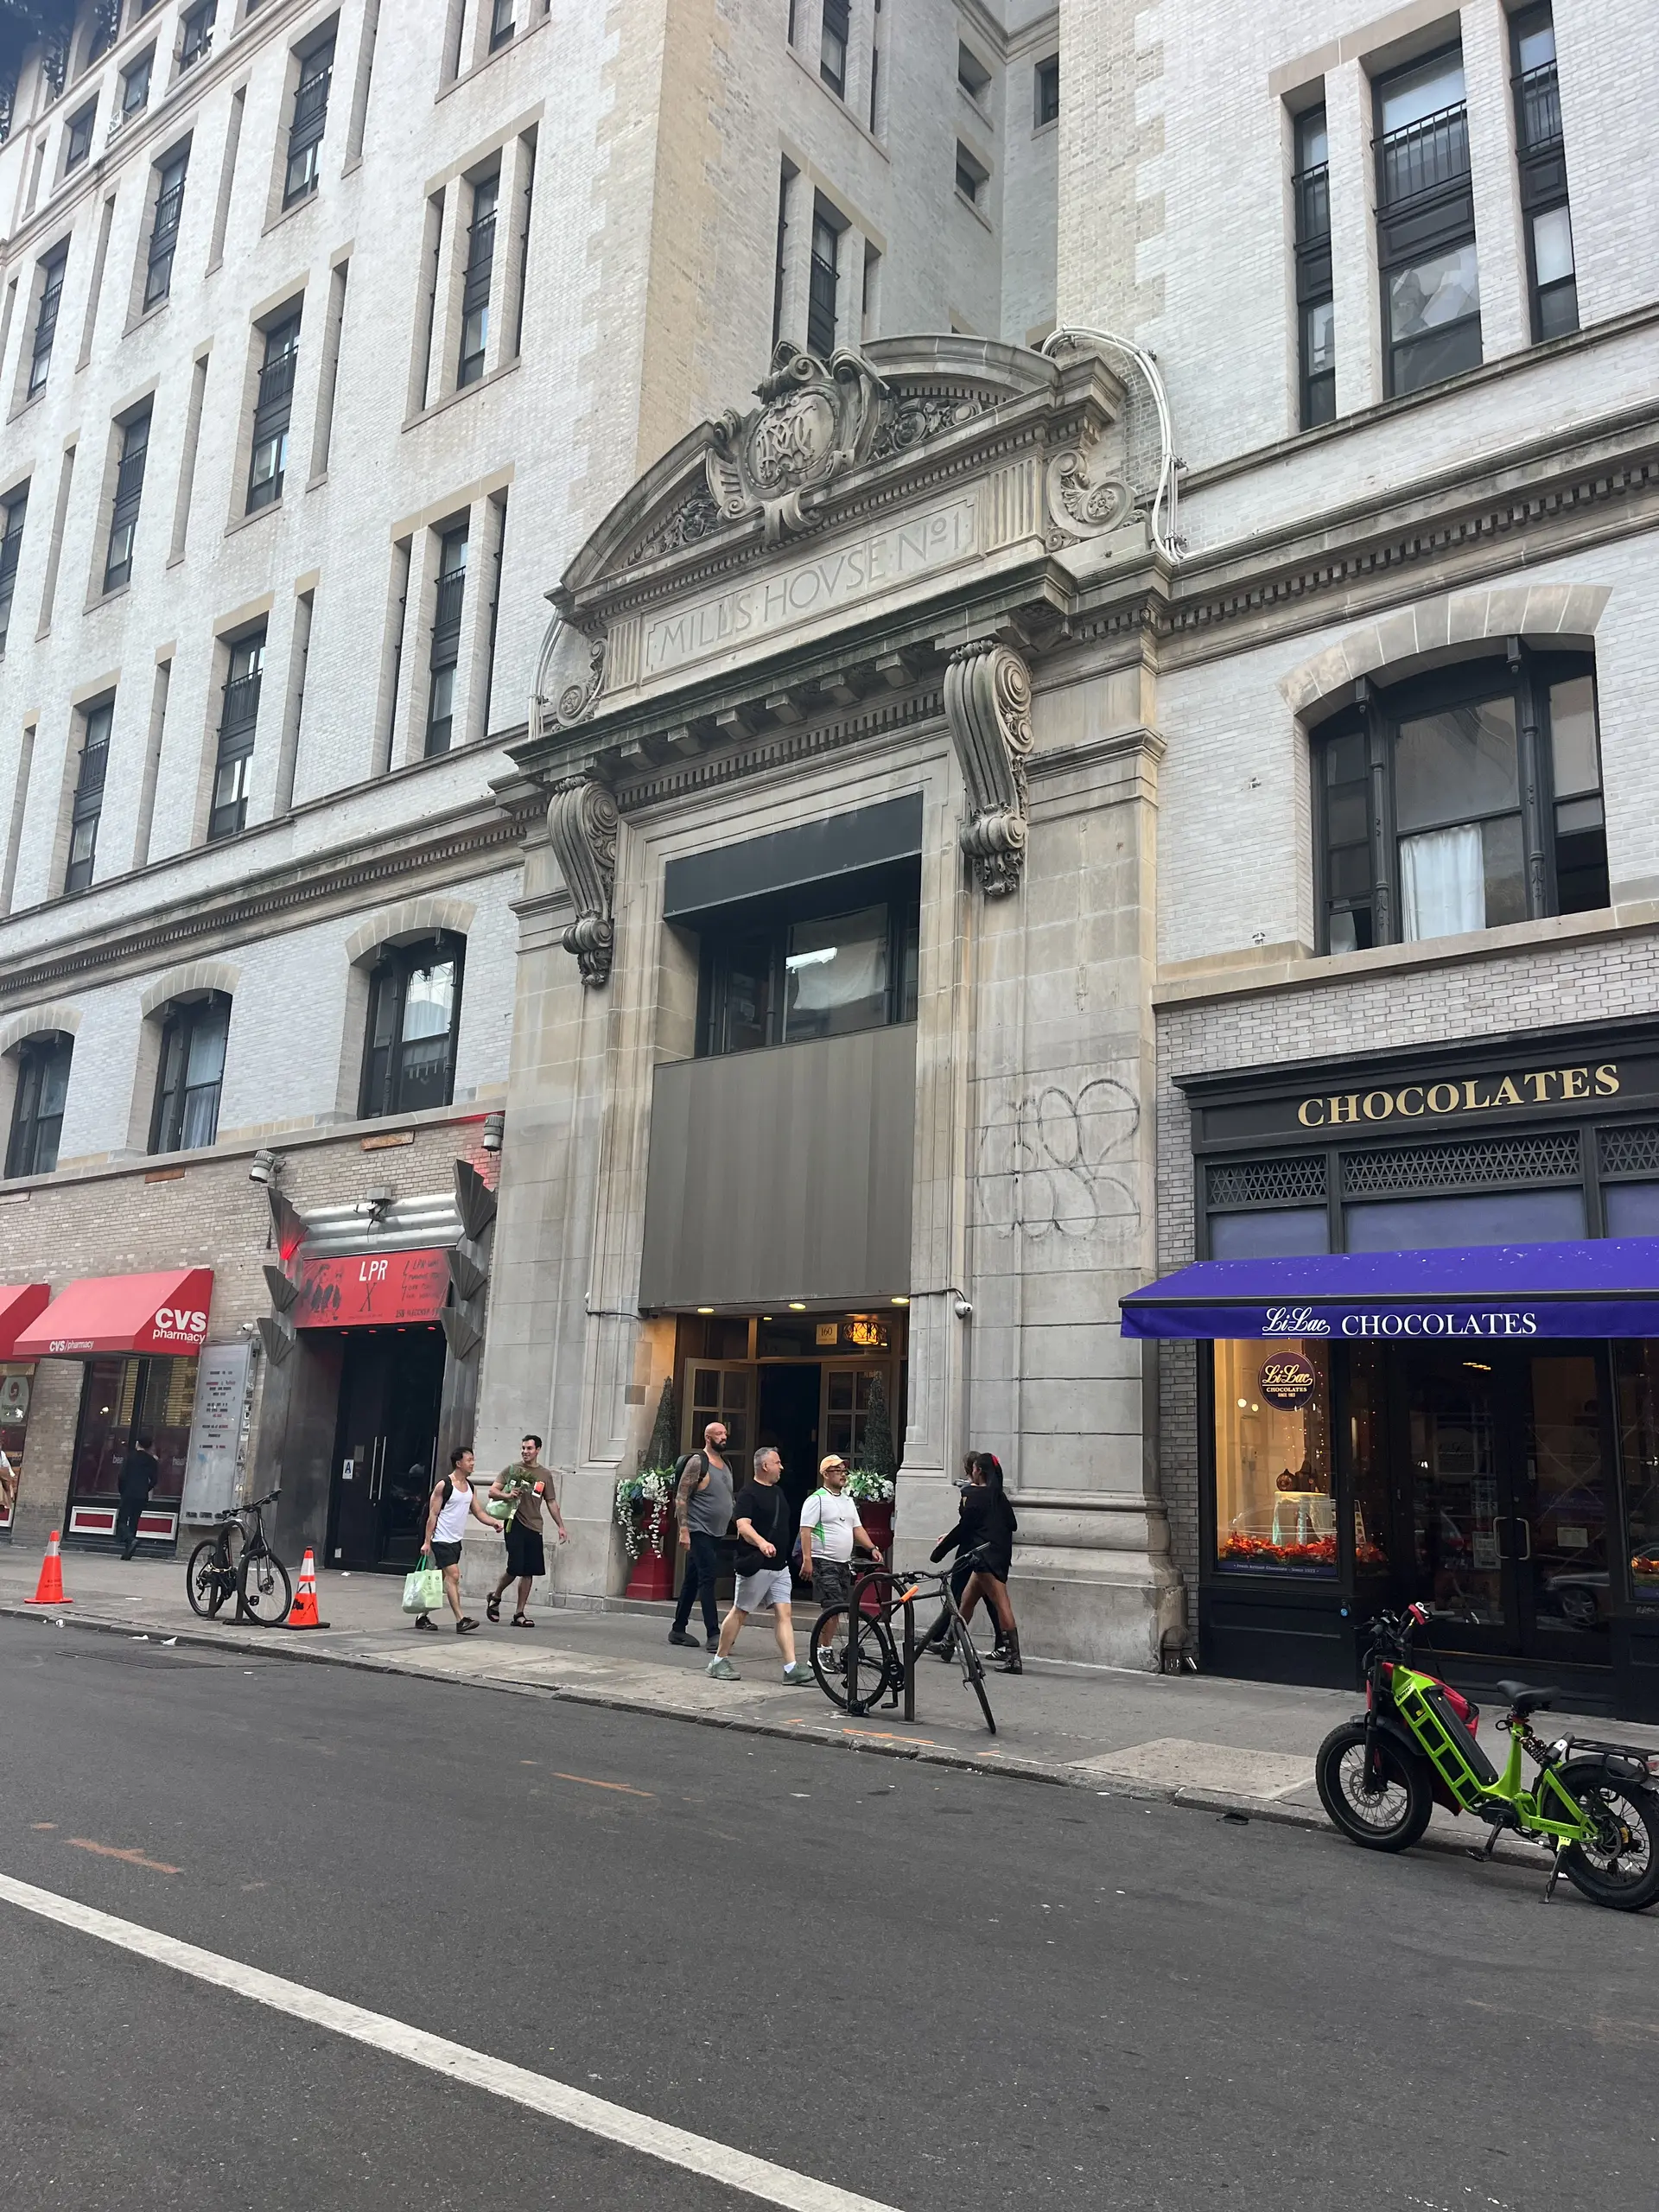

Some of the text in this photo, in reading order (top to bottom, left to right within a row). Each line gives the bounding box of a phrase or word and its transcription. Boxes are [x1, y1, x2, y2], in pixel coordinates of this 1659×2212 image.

[659, 594, 753, 663] MILLS
[1297, 1064, 1620, 1127] CHOCOLATES
[359, 1259, 388, 1281] LPR
[156, 1307, 207, 1332] CVS
[821, 1326, 833, 1337] 160
[1262, 1306, 1538, 1336] Li-Lac CHOCOLATES
[153, 1328, 206, 1344] pharmacy
[1262, 1363, 1313, 1387] Li-Lac
[345, 1461, 352, 1474] A
